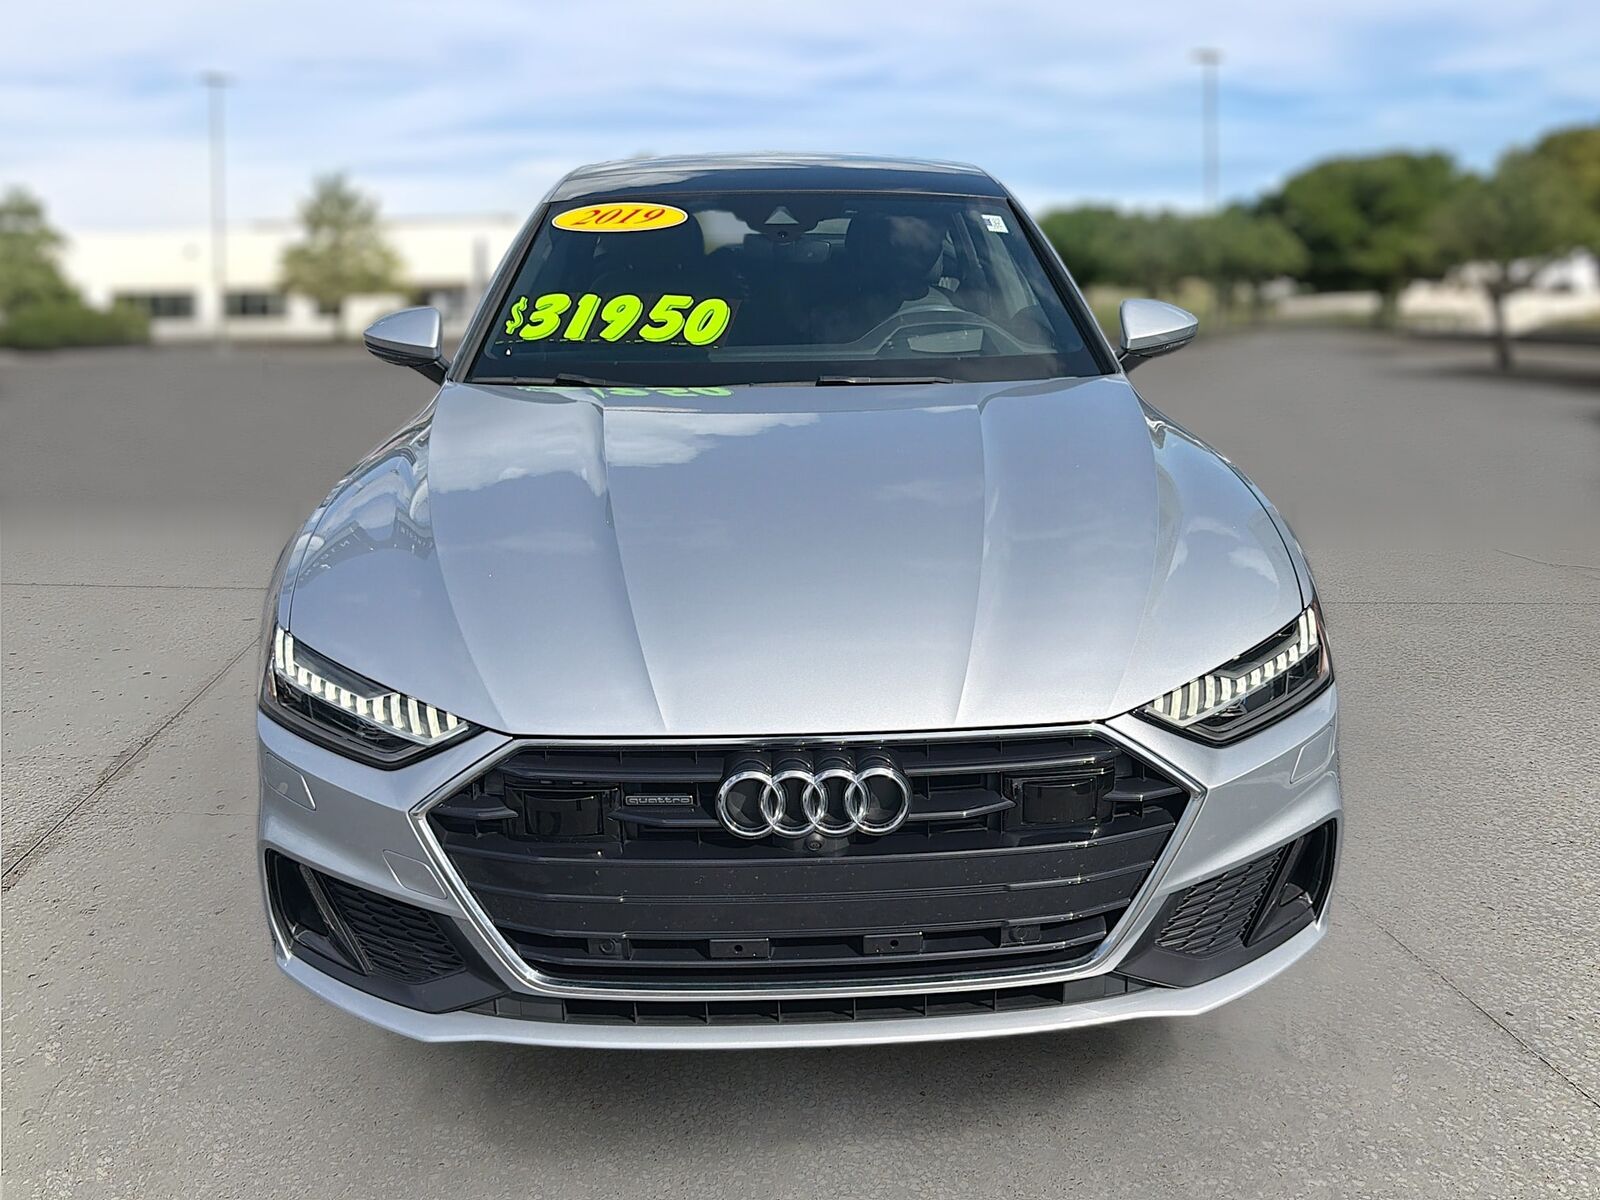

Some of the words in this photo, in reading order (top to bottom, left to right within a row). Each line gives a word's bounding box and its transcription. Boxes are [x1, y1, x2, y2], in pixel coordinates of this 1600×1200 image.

[571, 208, 666, 226] 2019
[506, 293, 731, 346] $31950
[629, 796, 691, 804] quattro
